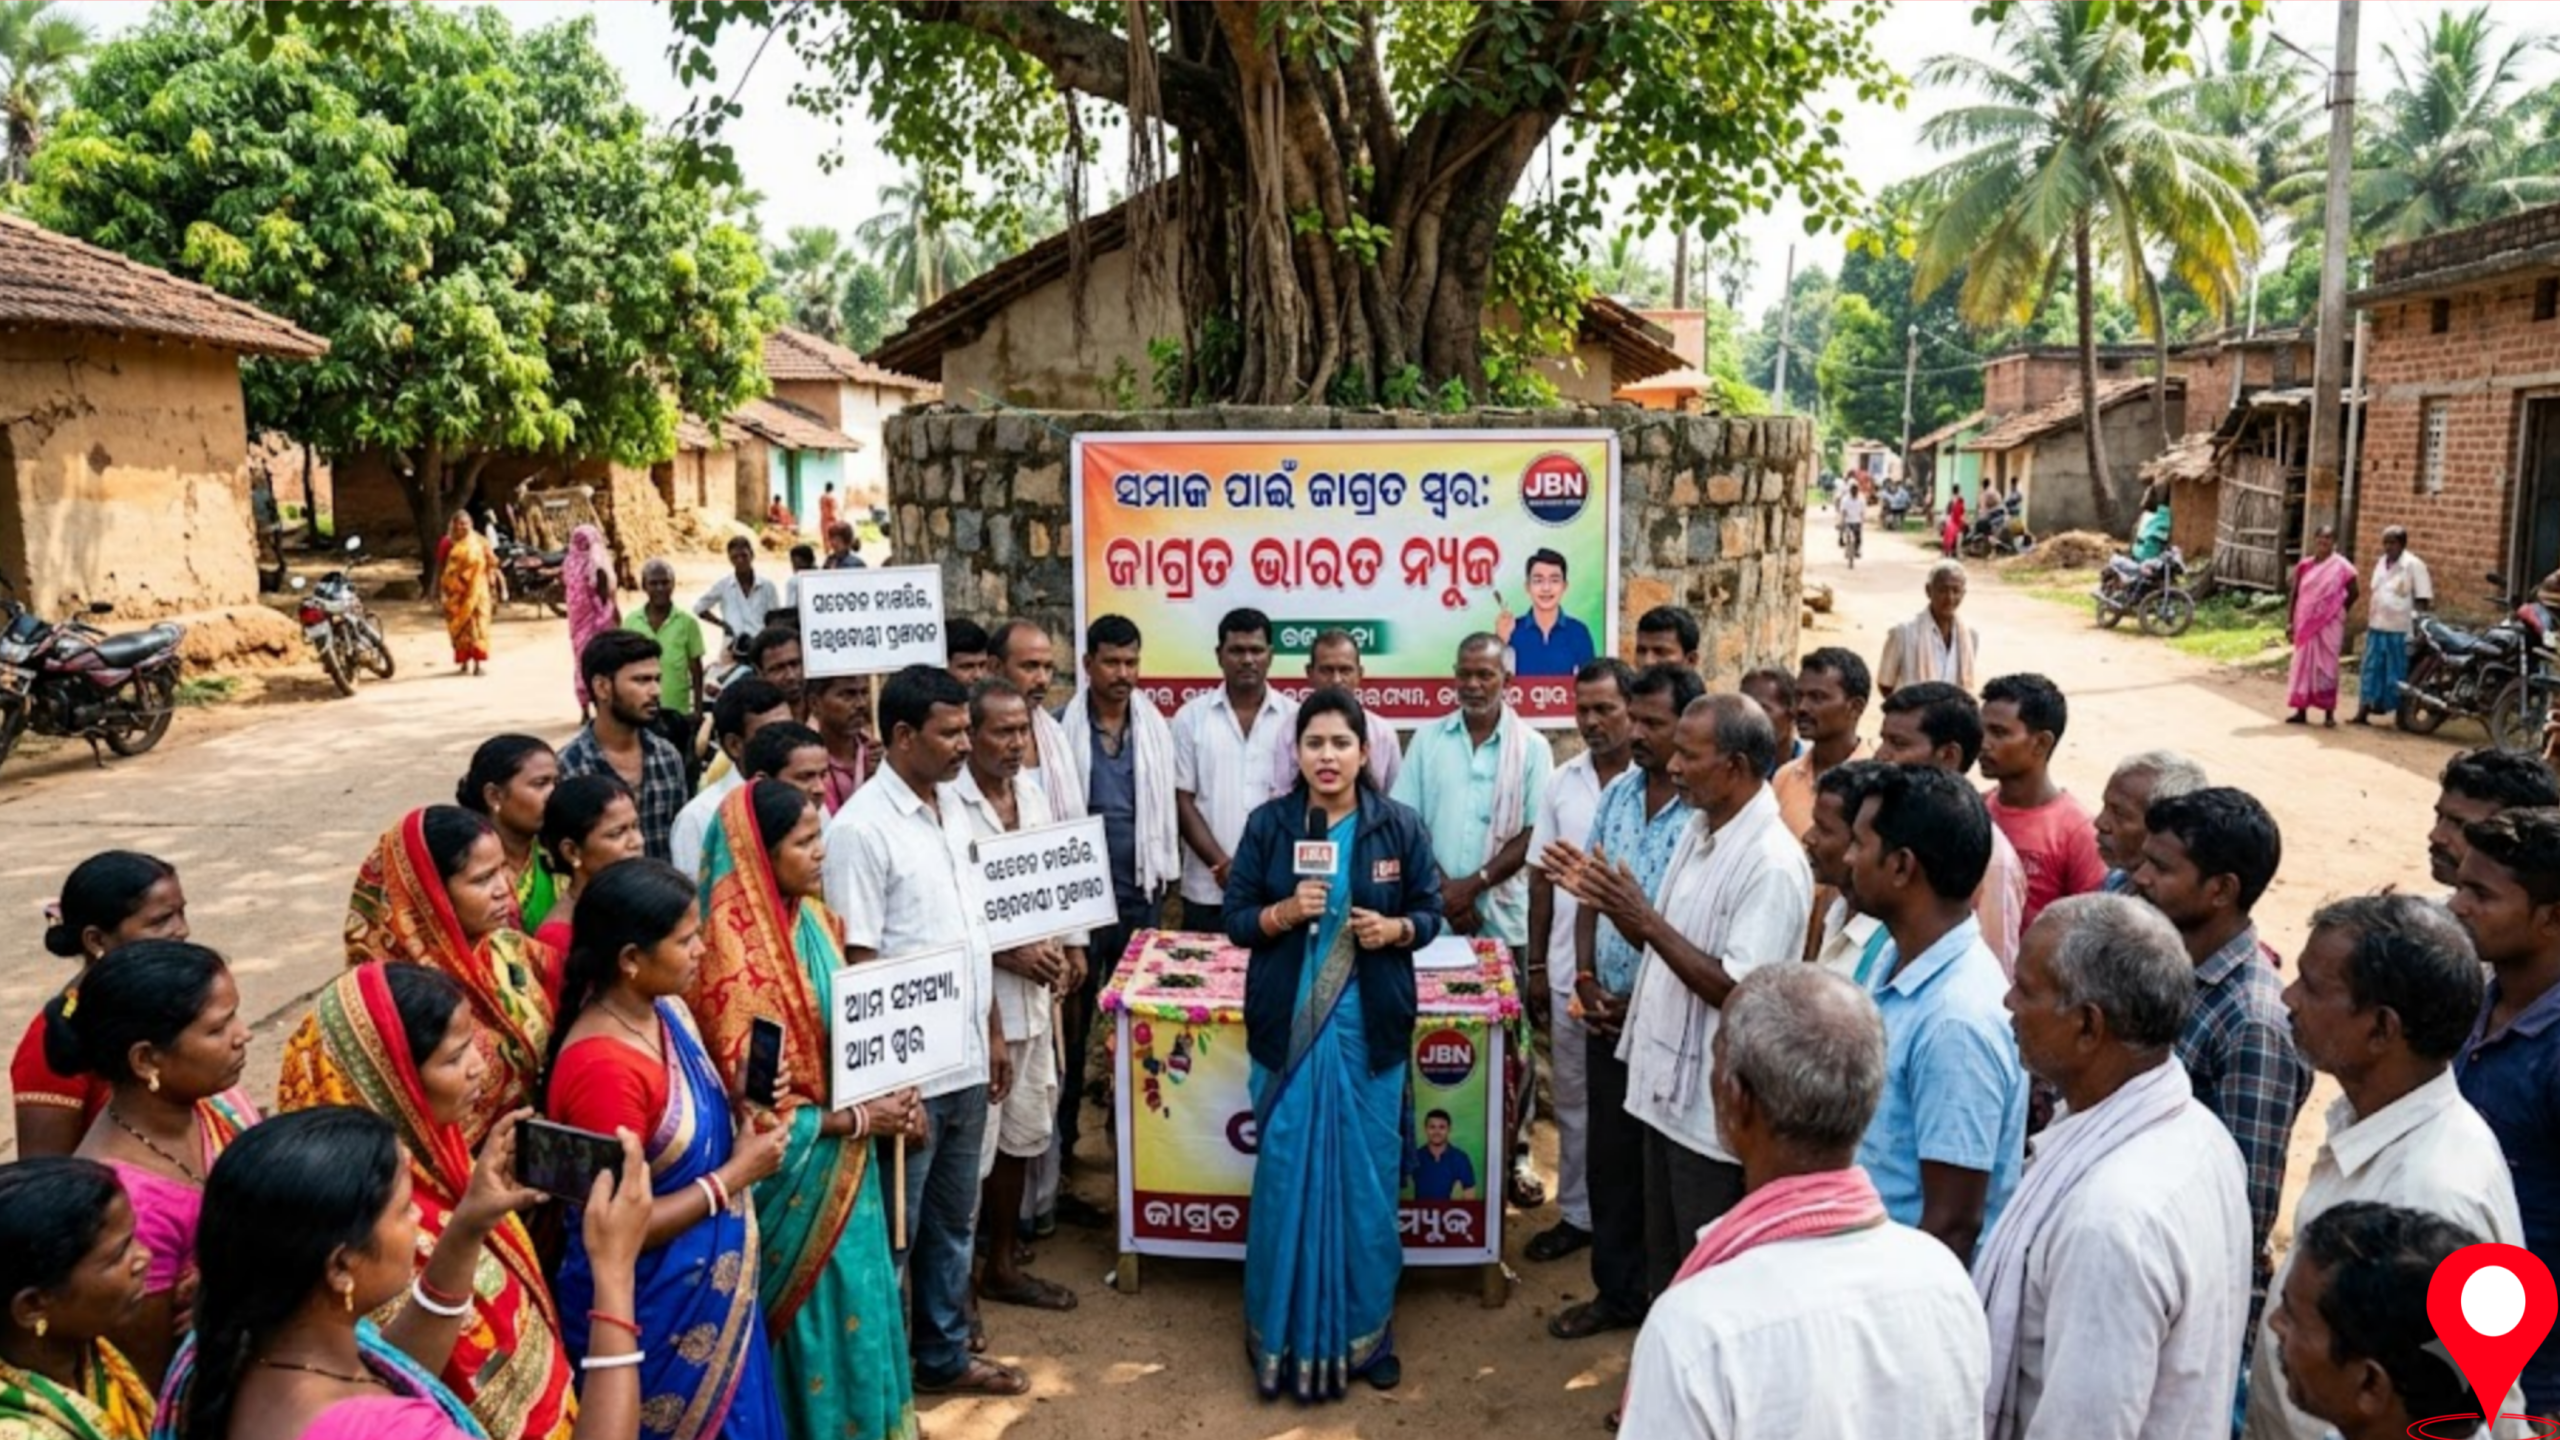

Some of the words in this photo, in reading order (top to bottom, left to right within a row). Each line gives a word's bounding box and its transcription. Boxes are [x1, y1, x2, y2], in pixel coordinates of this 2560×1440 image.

[1308, 472, 1407, 515] ଜାଗ୍ରତ
[1525, 472, 1583, 496] JBN
[1106, 537, 1233, 599] ଜାଗ୍ରତ
[1251, 537, 1383, 588] ଭାରତ
[845, 987, 884, 1024] ଆମ
[845, 1034, 885, 1071] ଆମ
[1420, 1044, 1471, 1064] JBN
